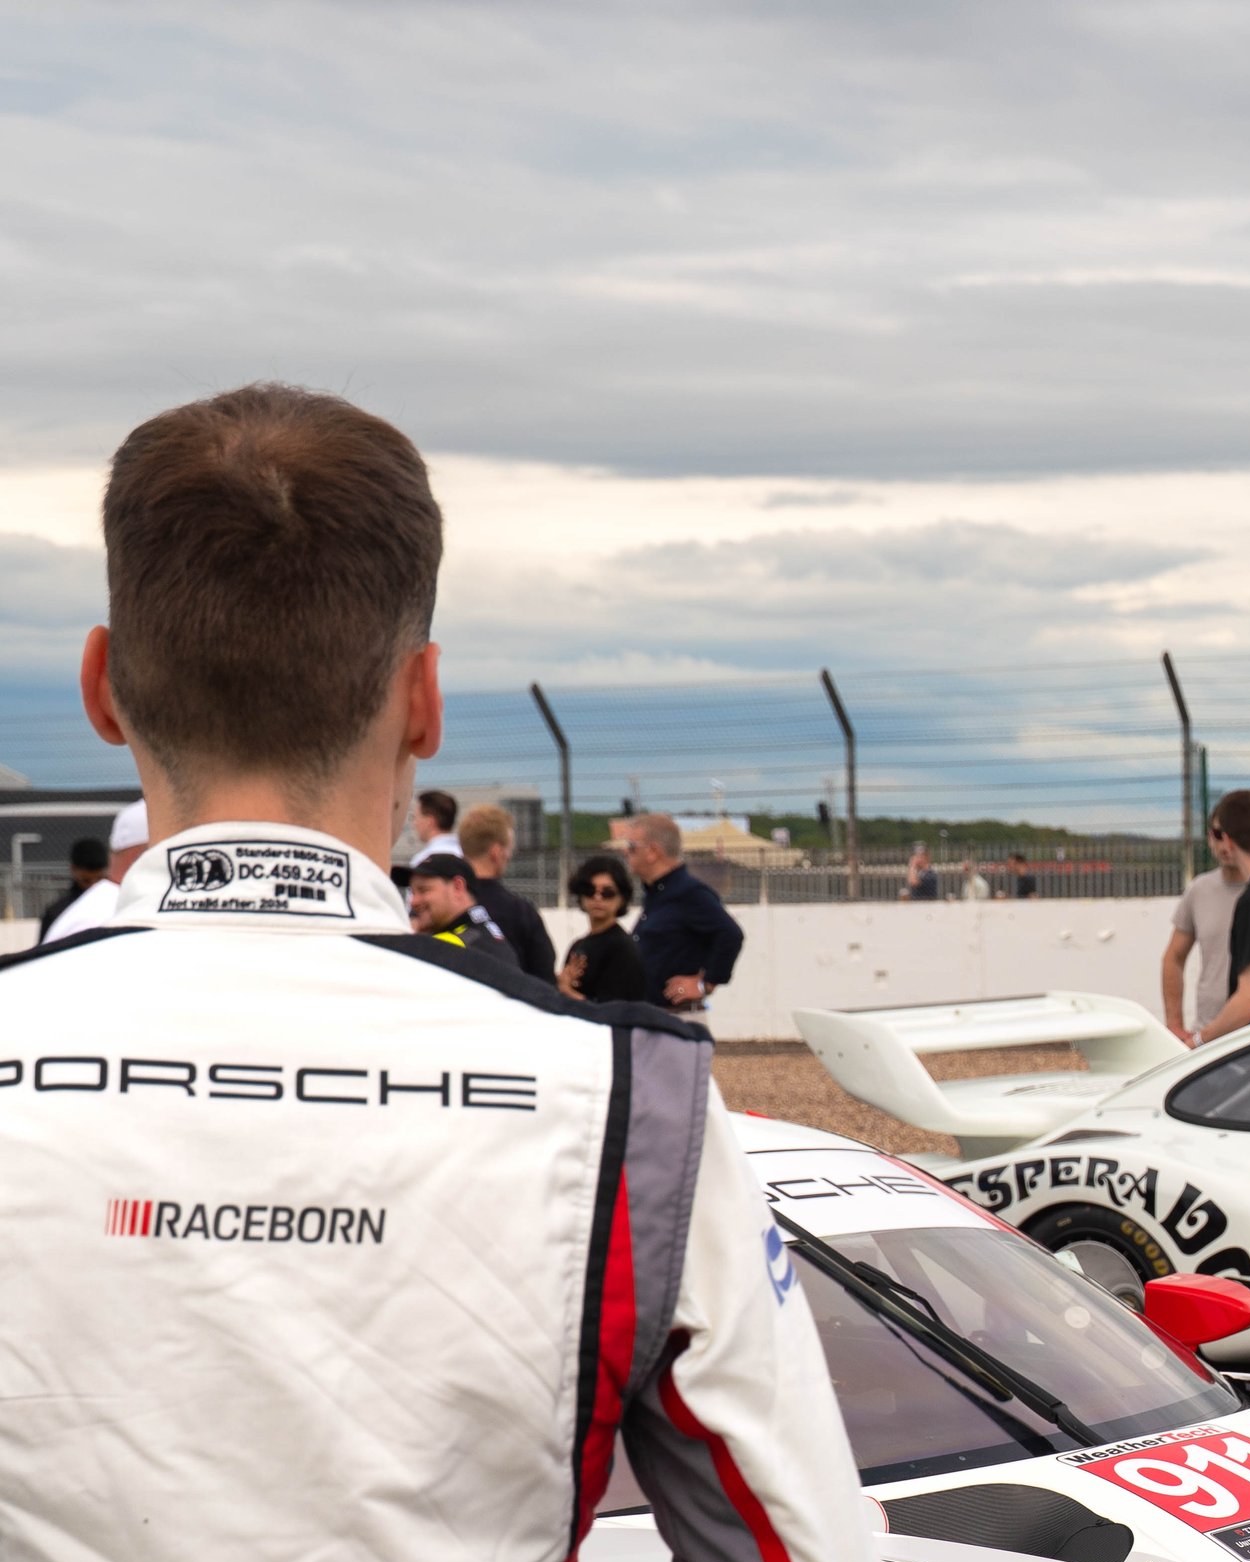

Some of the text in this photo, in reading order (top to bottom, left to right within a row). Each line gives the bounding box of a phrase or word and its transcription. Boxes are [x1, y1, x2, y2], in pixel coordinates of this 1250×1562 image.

[236, 847, 290, 859] Standard
[168, 899, 187, 909] Not
[191, 898, 219, 909] valid
[154, 1201, 386, 1244] RACEBORN
[1066, 1426, 1220, 1464] WeatherTech
